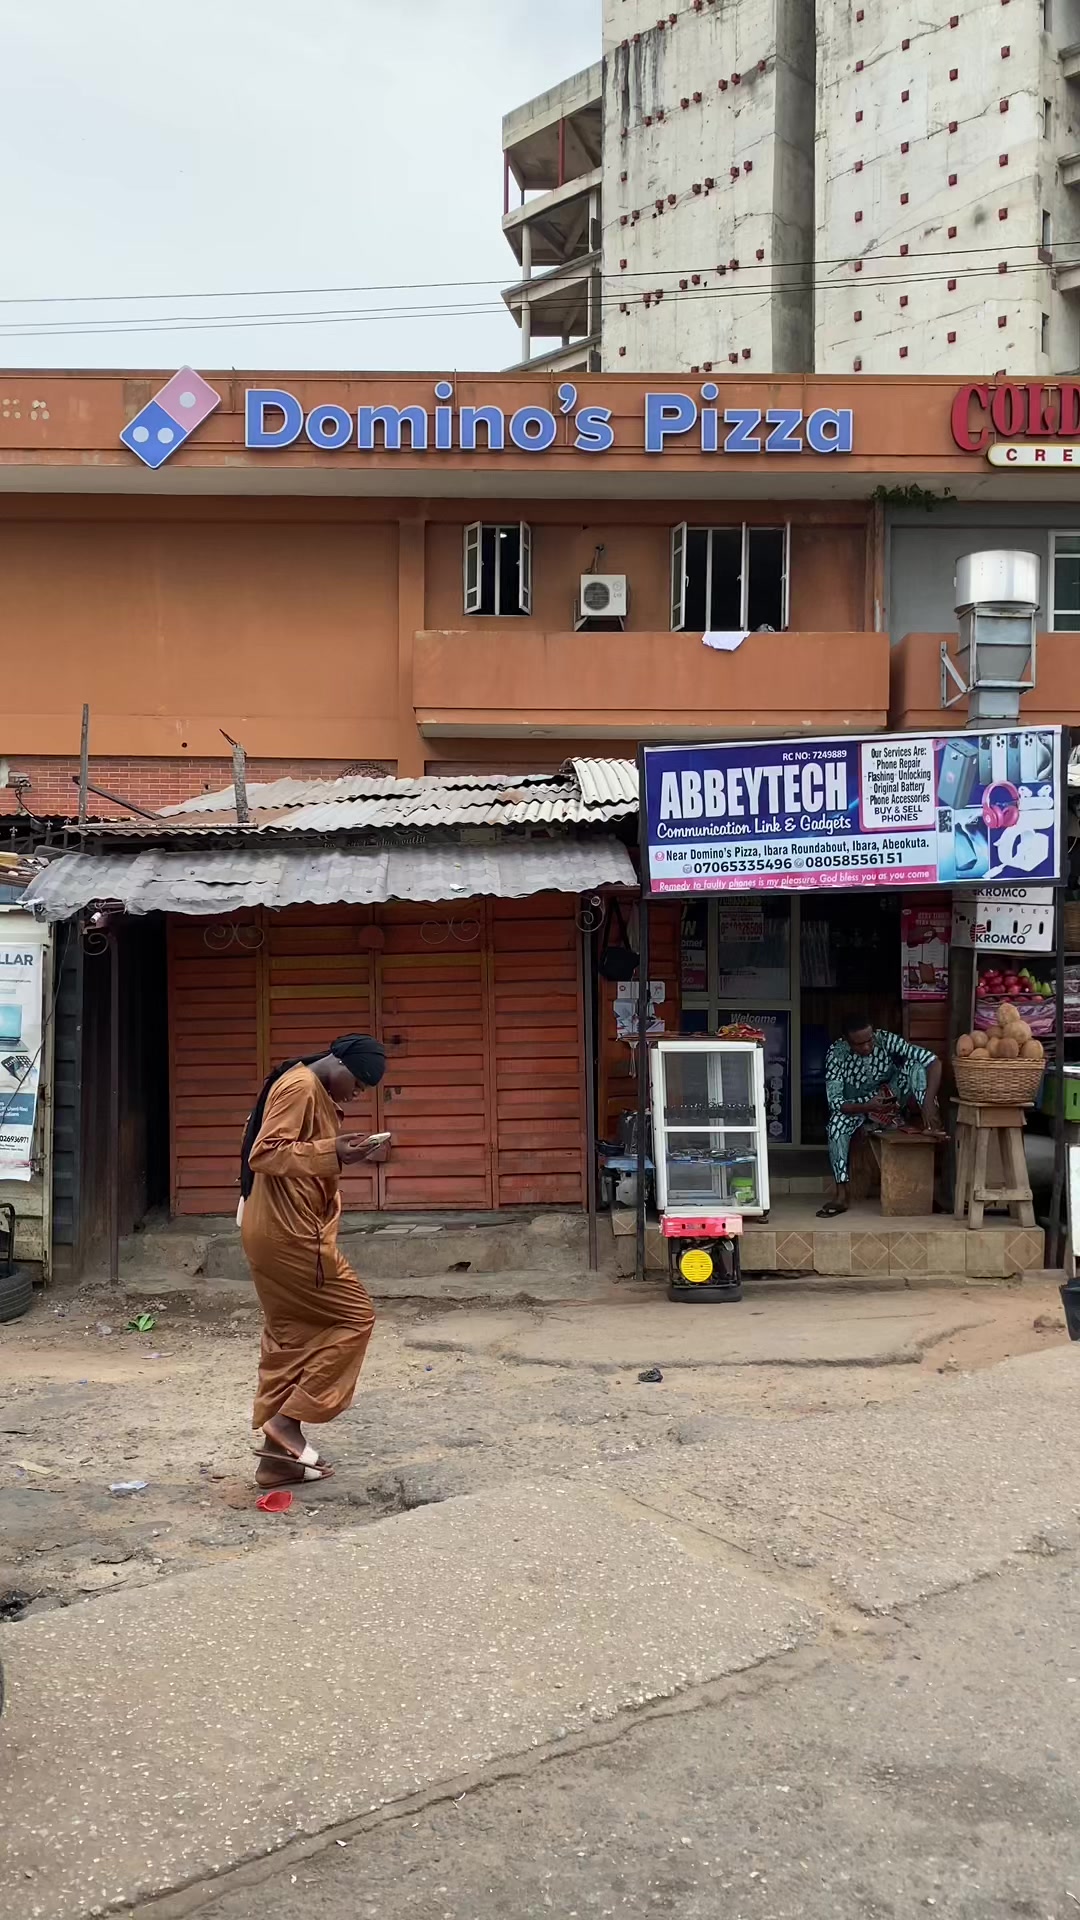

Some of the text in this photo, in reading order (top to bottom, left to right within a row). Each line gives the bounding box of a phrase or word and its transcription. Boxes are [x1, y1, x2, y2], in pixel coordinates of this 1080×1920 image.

[245, 381, 853, 453] Domino's Pizza
[951, 383, 1080, 451] COLD
[1006, 448, 1073, 461] CRE
[783, 750, 847, 761] RC NO: 7249889
[871, 746, 927, 758] Our Services Are:
[876, 757, 921, 770] Phone Repair
[867, 769, 931, 783] Flashing Unlocking
[660, 762, 848, 820] ABBEYTECH
[873, 781, 925, 795] Original Battery
[870, 794, 930, 805] Phone Accessories
[874, 806, 892, 814] BUY
[881, 813, 918, 822] PHONES
[657, 814, 852, 840] Communication Link & Gadgets
[666, 838, 929, 861] Near Domino's Pizza, Ibara Roundabout, Ibara, Abeokuta.
[693, 852, 902, 874] 07065335496 08058556151
[660, 880, 690, 891] Remedy
[693, 880, 702, 889] to
[704, 879, 727, 890] faulty
[728, 878, 756, 889] phones
[759, 877, 765, 886] is
[766, 879, 778, 887] my
[781, 875, 818, 887] pleasure,
[820, 873, 838, 883] God
[840, 872, 859, 881] bless
[861, 873, 877, 883] you
[889, 872, 905, 881] you
[976, 888, 1027, 898] KROMCO
[975, 934, 1026, 945] KROMCO
[730, 1013, 777, 1024] Welcome
